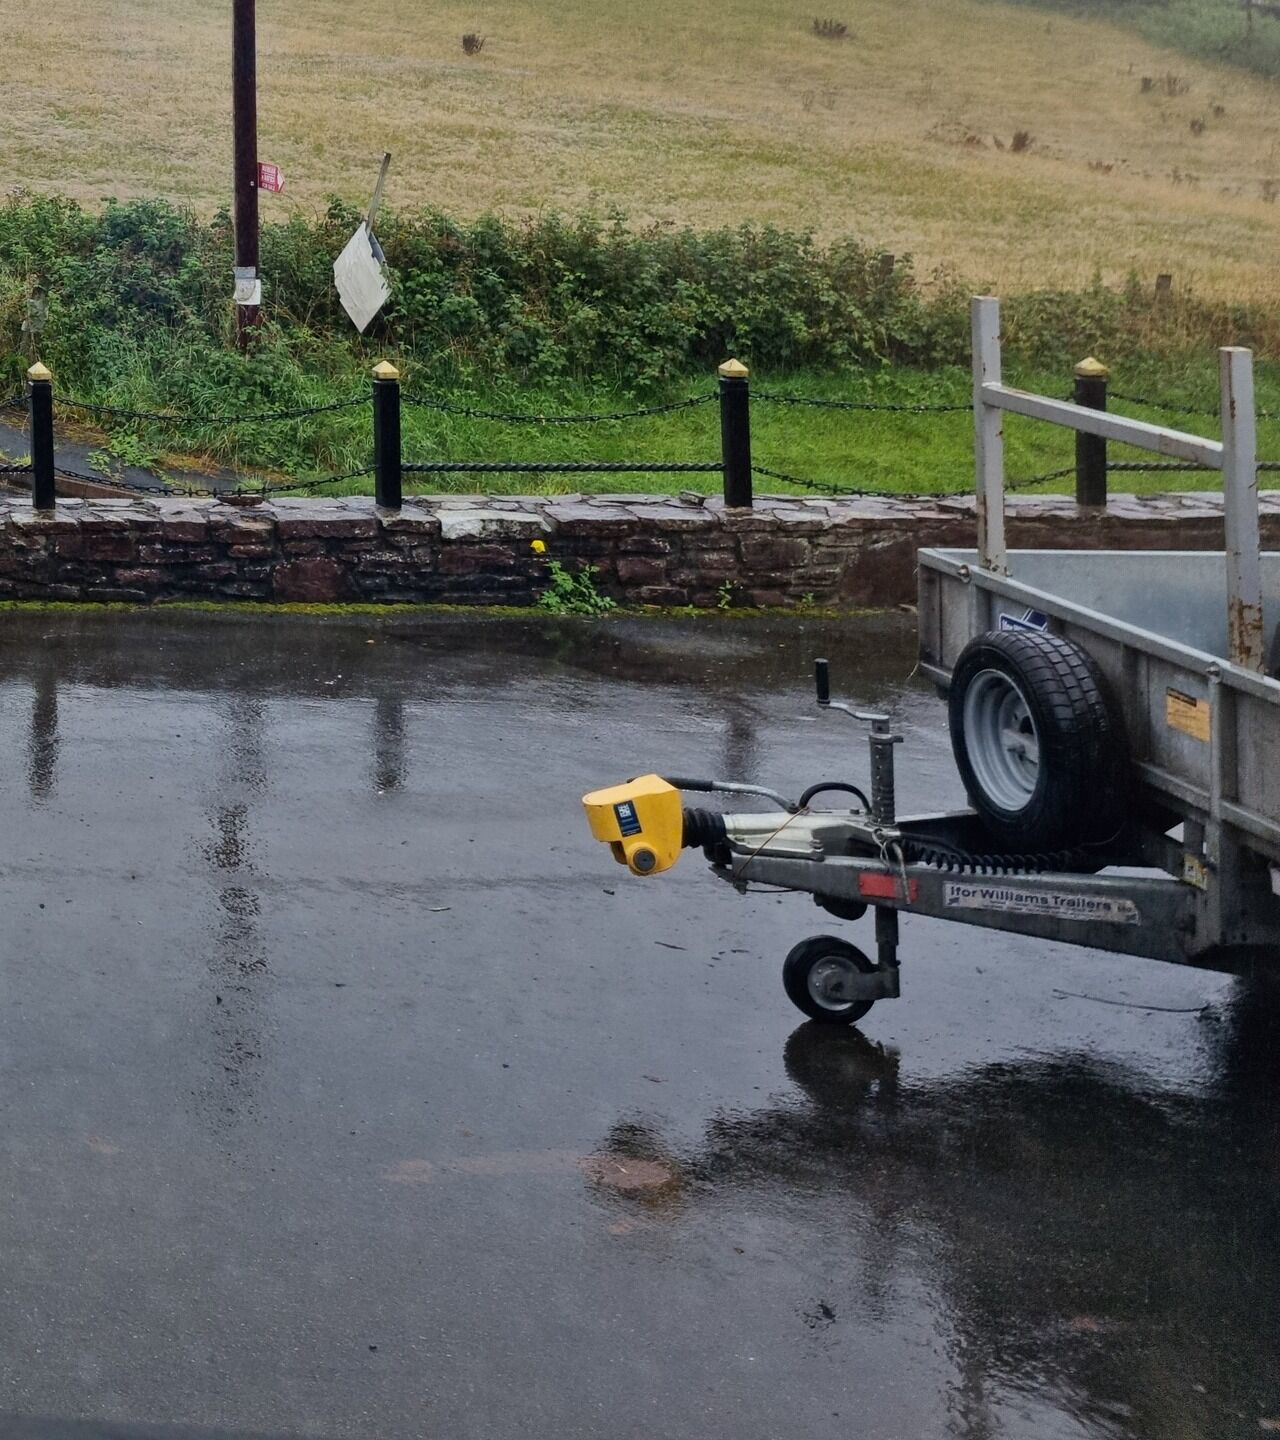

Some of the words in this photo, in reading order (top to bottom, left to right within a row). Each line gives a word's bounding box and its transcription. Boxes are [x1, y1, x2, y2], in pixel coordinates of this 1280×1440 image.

[950, 886, 977, 898] Ifor
[979, 889, 1049, 905] Williams
[1052, 895, 1112, 912] Trailers
